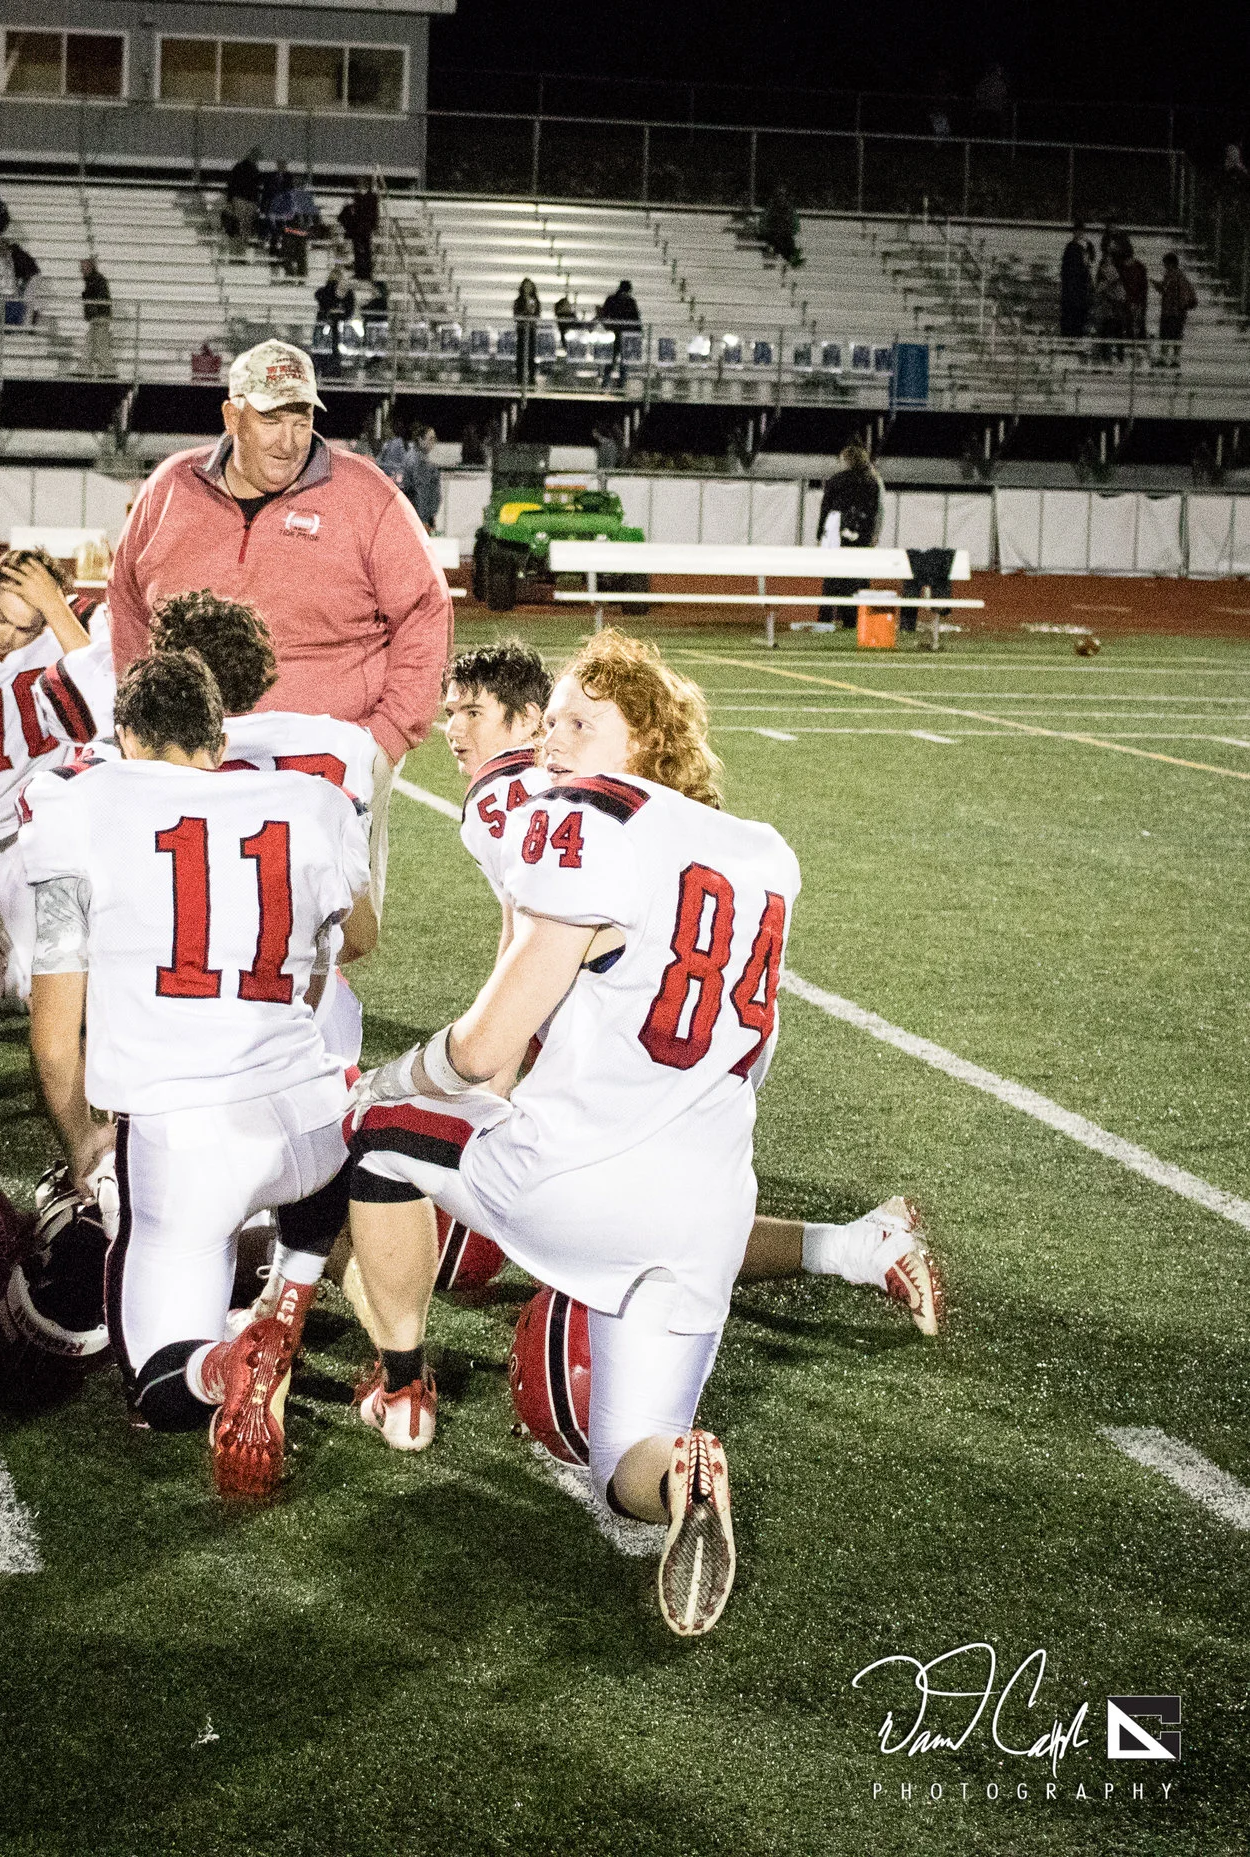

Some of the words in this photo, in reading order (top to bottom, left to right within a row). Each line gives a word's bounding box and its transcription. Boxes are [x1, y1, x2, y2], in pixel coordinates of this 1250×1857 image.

[477, 779, 532, 839] 54
[521, 809, 584, 868] 84
[155, 816, 294, 1004] 11
[637, 861, 786, 1083] 84
